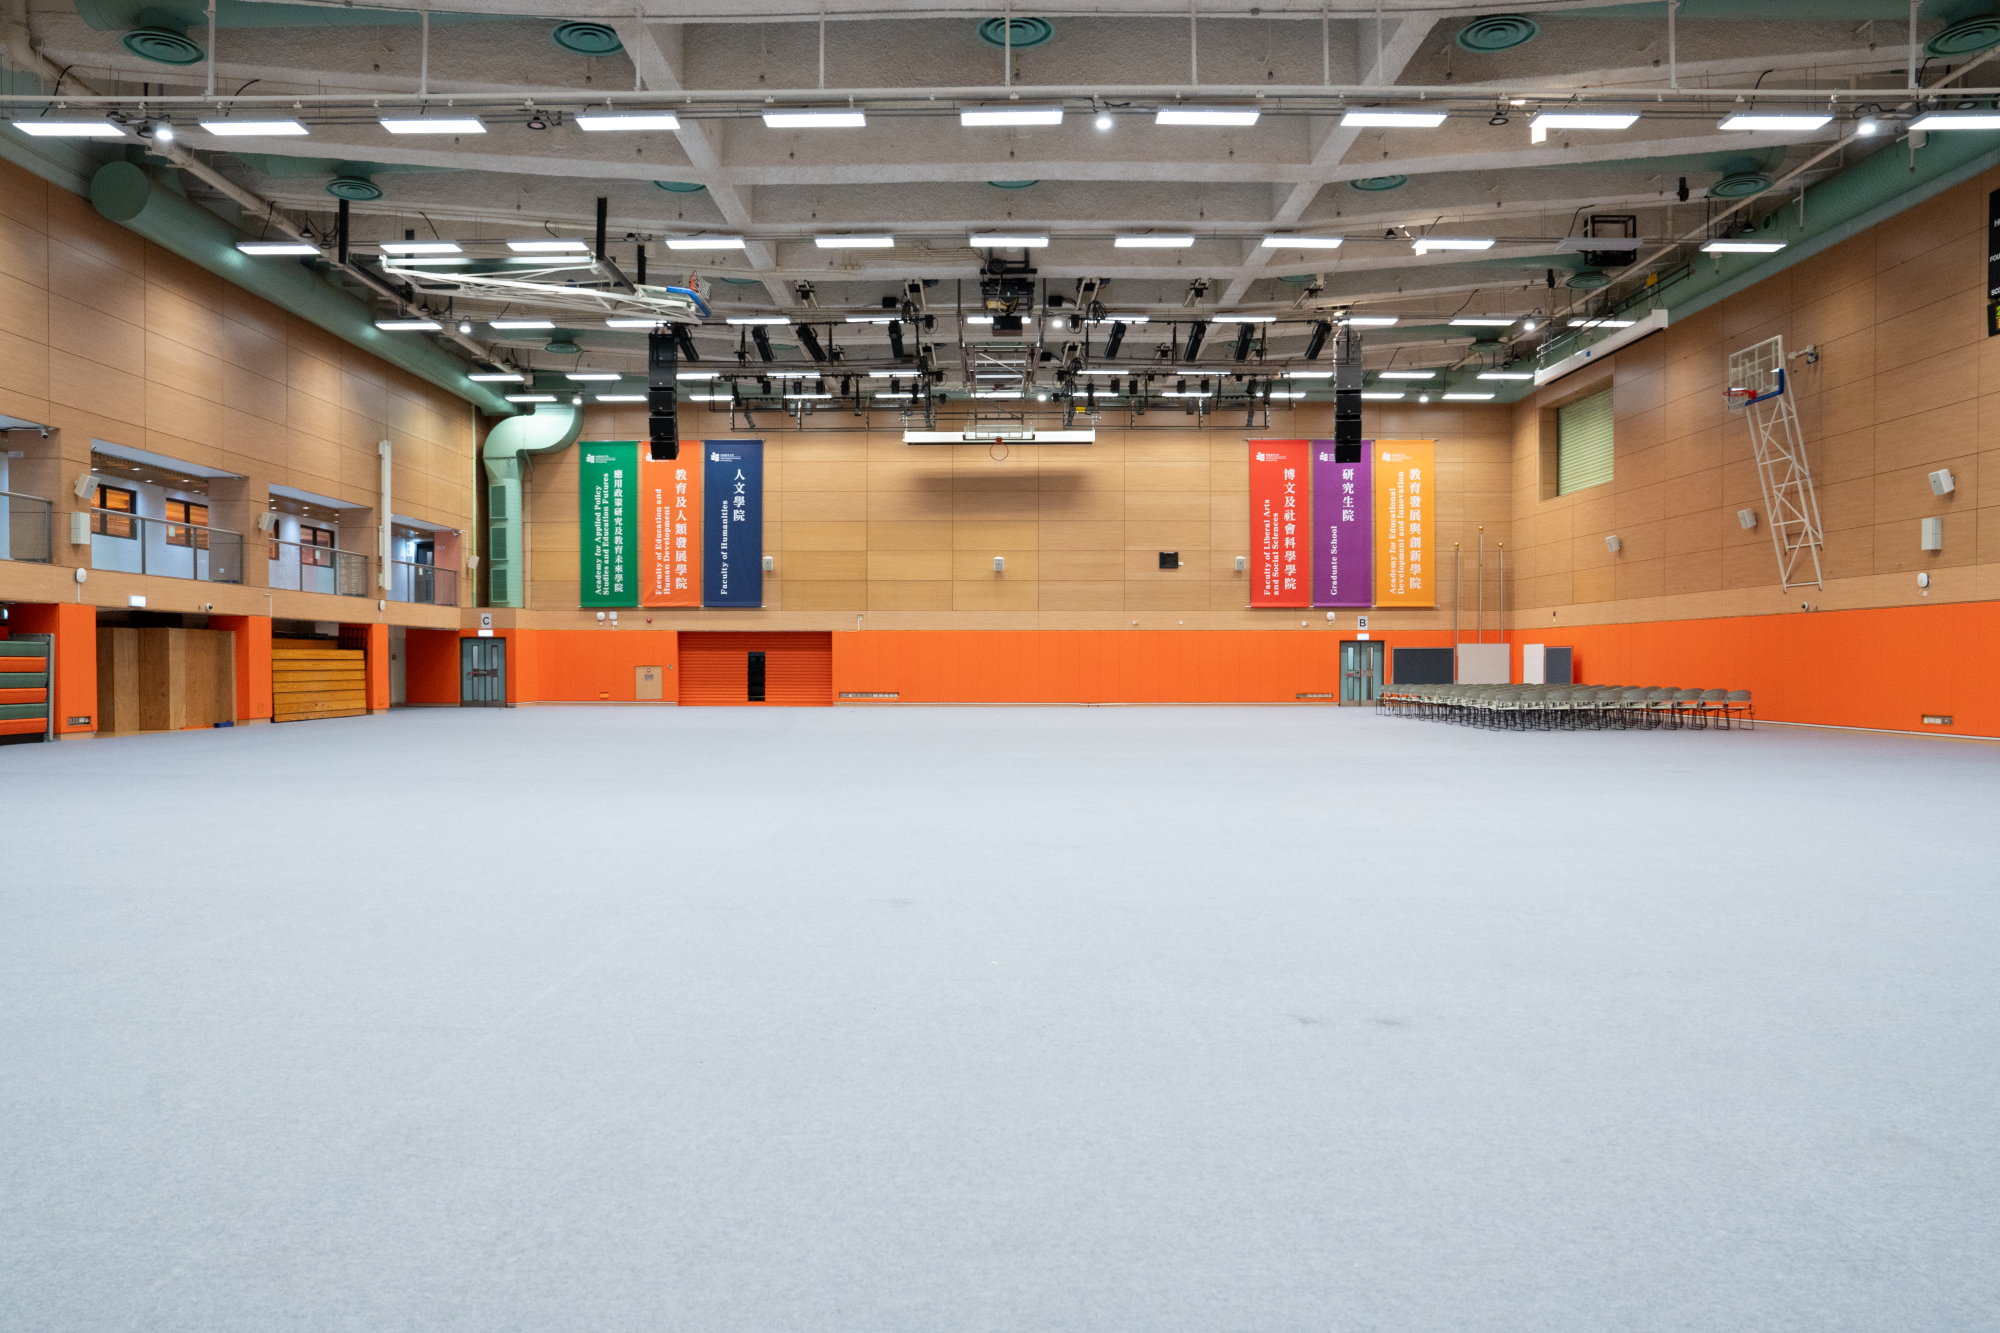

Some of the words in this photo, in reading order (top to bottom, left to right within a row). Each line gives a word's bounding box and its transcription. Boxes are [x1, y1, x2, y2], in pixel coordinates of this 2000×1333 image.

[594, 485, 602, 510] Policy
[733, 468, 745, 522] 人文學院
[1342, 468, 1354, 522] 研究生院
[594, 512, 602, 543] Applied
[675, 468, 687, 590] 教育及人類發展學院
[1283, 468, 1296, 590] 博文及社會科學學院
[1388, 488, 1396, 539] Educational
[1409, 468, 1421, 590] 教育發展與創新學院
[594, 544, 602, 556] for
[663, 506, 671, 562] Development
[1330, 525, 1338, 555] School
[655, 551, 662, 560] of
[721, 551, 728, 560] of
[1263, 551, 1270, 560] of
[1397, 539, 1405, 595] Development
[594, 558, 602, 595] Academy
[655, 562, 663, 595] Faculty
[721, 561, 729, 595] Faculty
[1263, 562, 1271, 595] Faculty
[1330, 556, 1338, 596] Graduate
[1389, 555, 1397, 595] Academy
[482, 616, 490, 625] C
[1359, 618, 1366, 627] B
